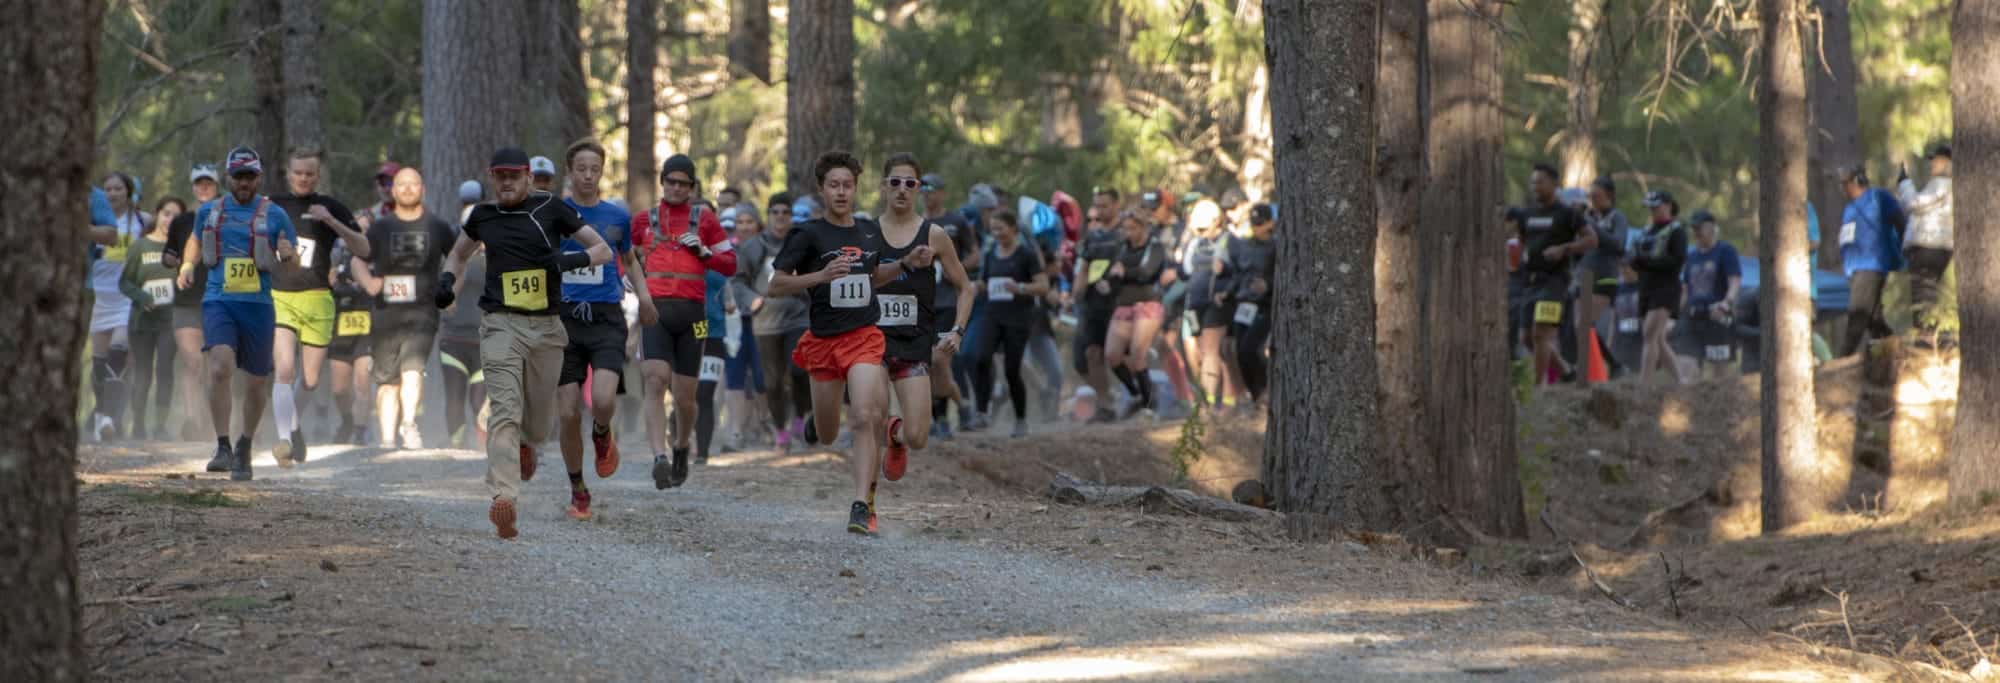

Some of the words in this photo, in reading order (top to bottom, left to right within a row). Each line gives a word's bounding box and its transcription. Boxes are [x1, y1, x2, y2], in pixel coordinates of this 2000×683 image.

[231, 264, 255, 278] 570
[511, 275, 540, 296] 549
[840, 282, 865, 299] 111
[884, 302, 910, 318] 198
